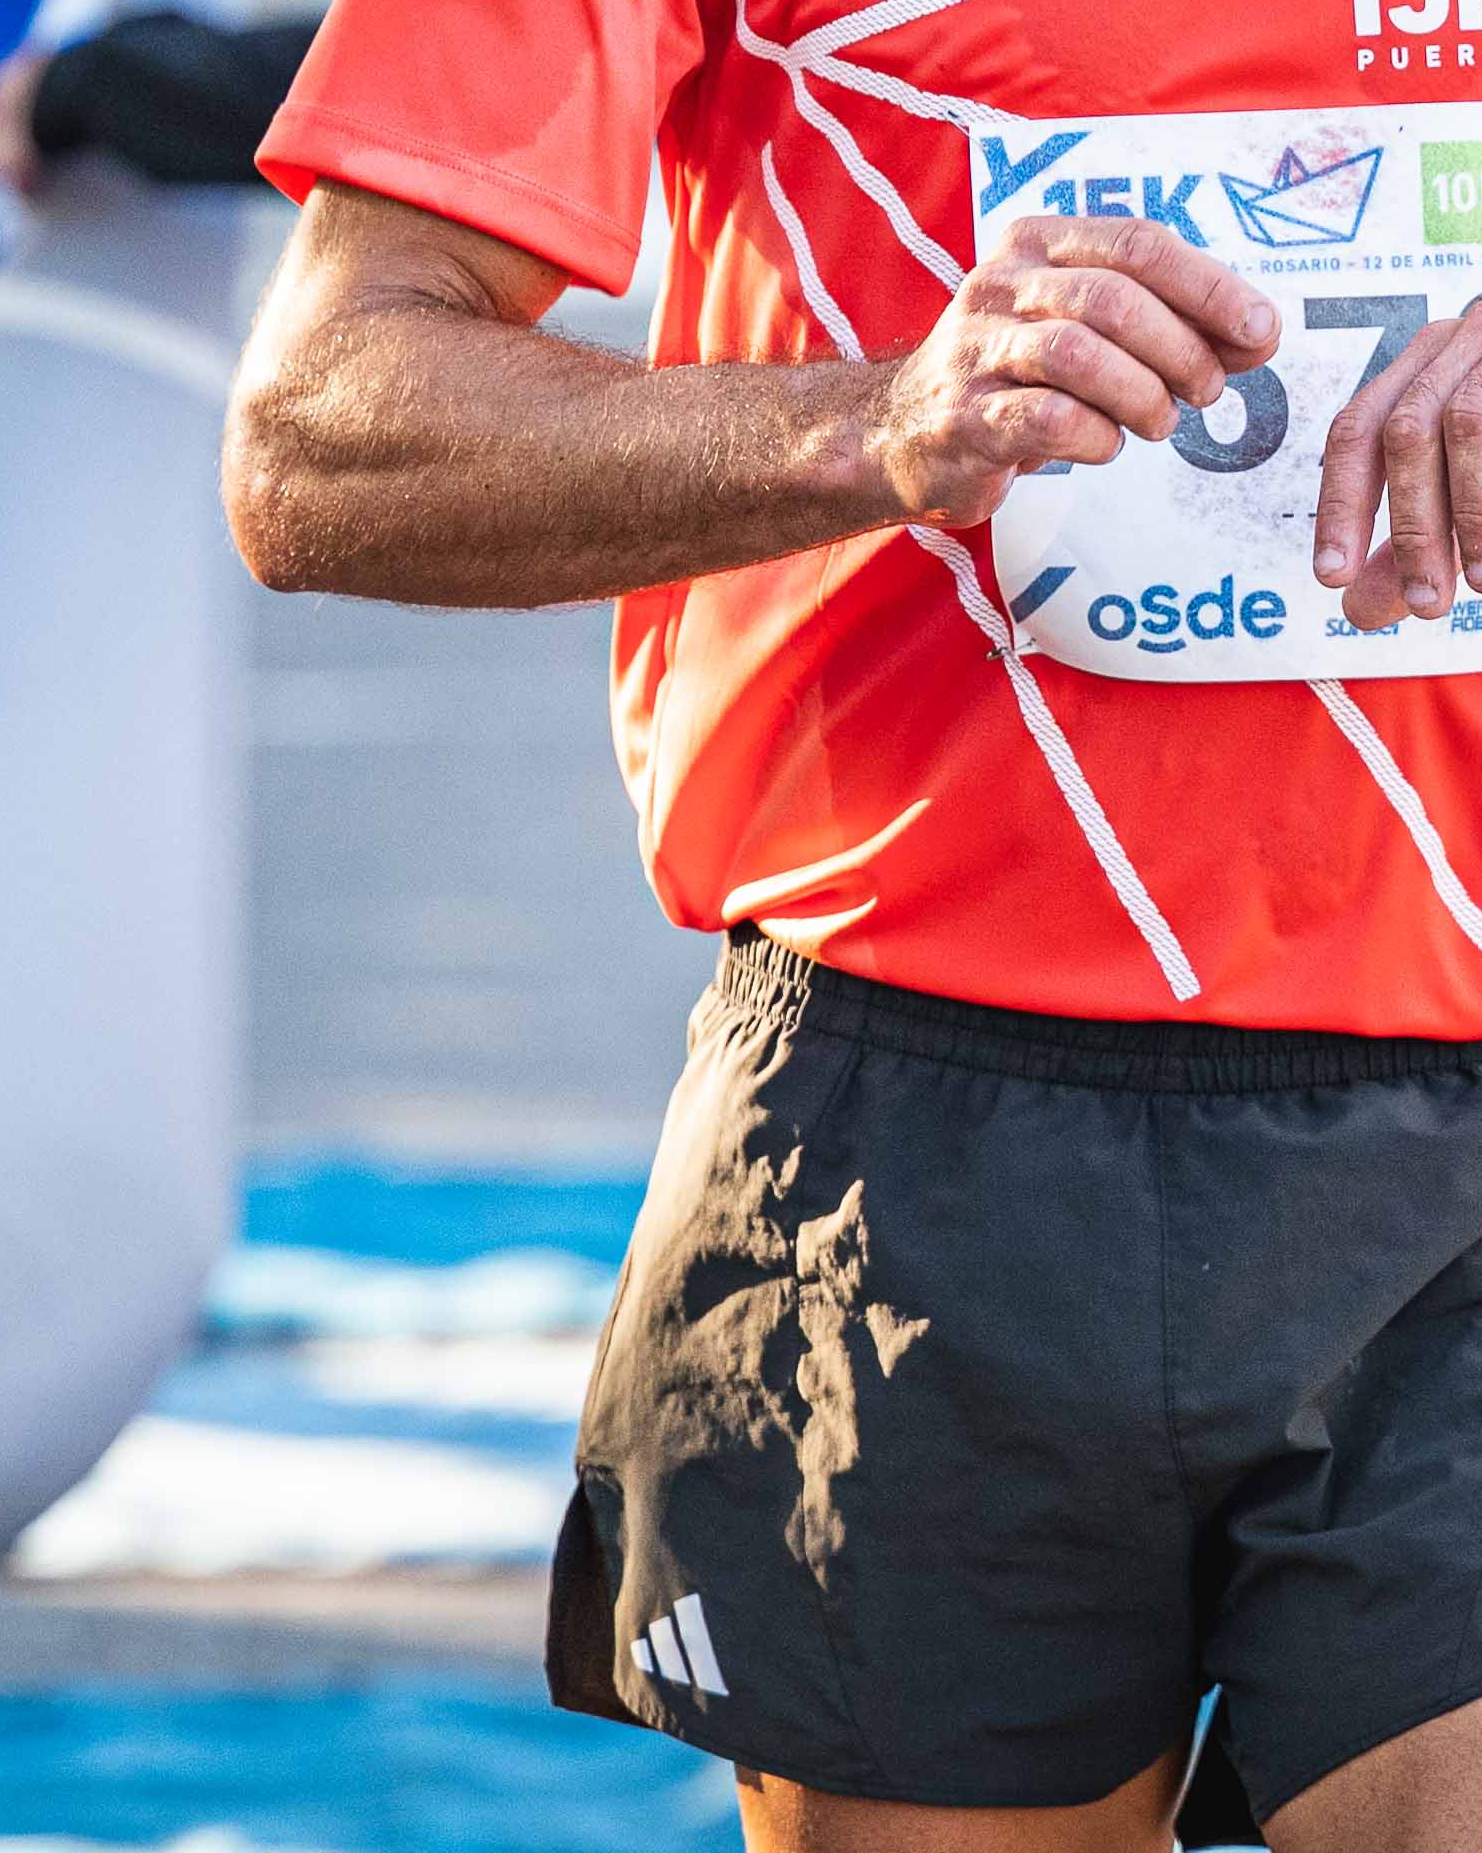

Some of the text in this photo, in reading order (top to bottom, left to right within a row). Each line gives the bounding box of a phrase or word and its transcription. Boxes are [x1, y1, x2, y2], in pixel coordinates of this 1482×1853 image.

[1043, 174, 1209, 248] 15K
[1260, 257, 1341, 274] ROSARIO
[1363, 255, 1383, 270] 12
[1390, 254, 1414, 269] DE
[1421, 252, 1474, 268] ABRIL
[1087, 572, 1287, 642] osde
